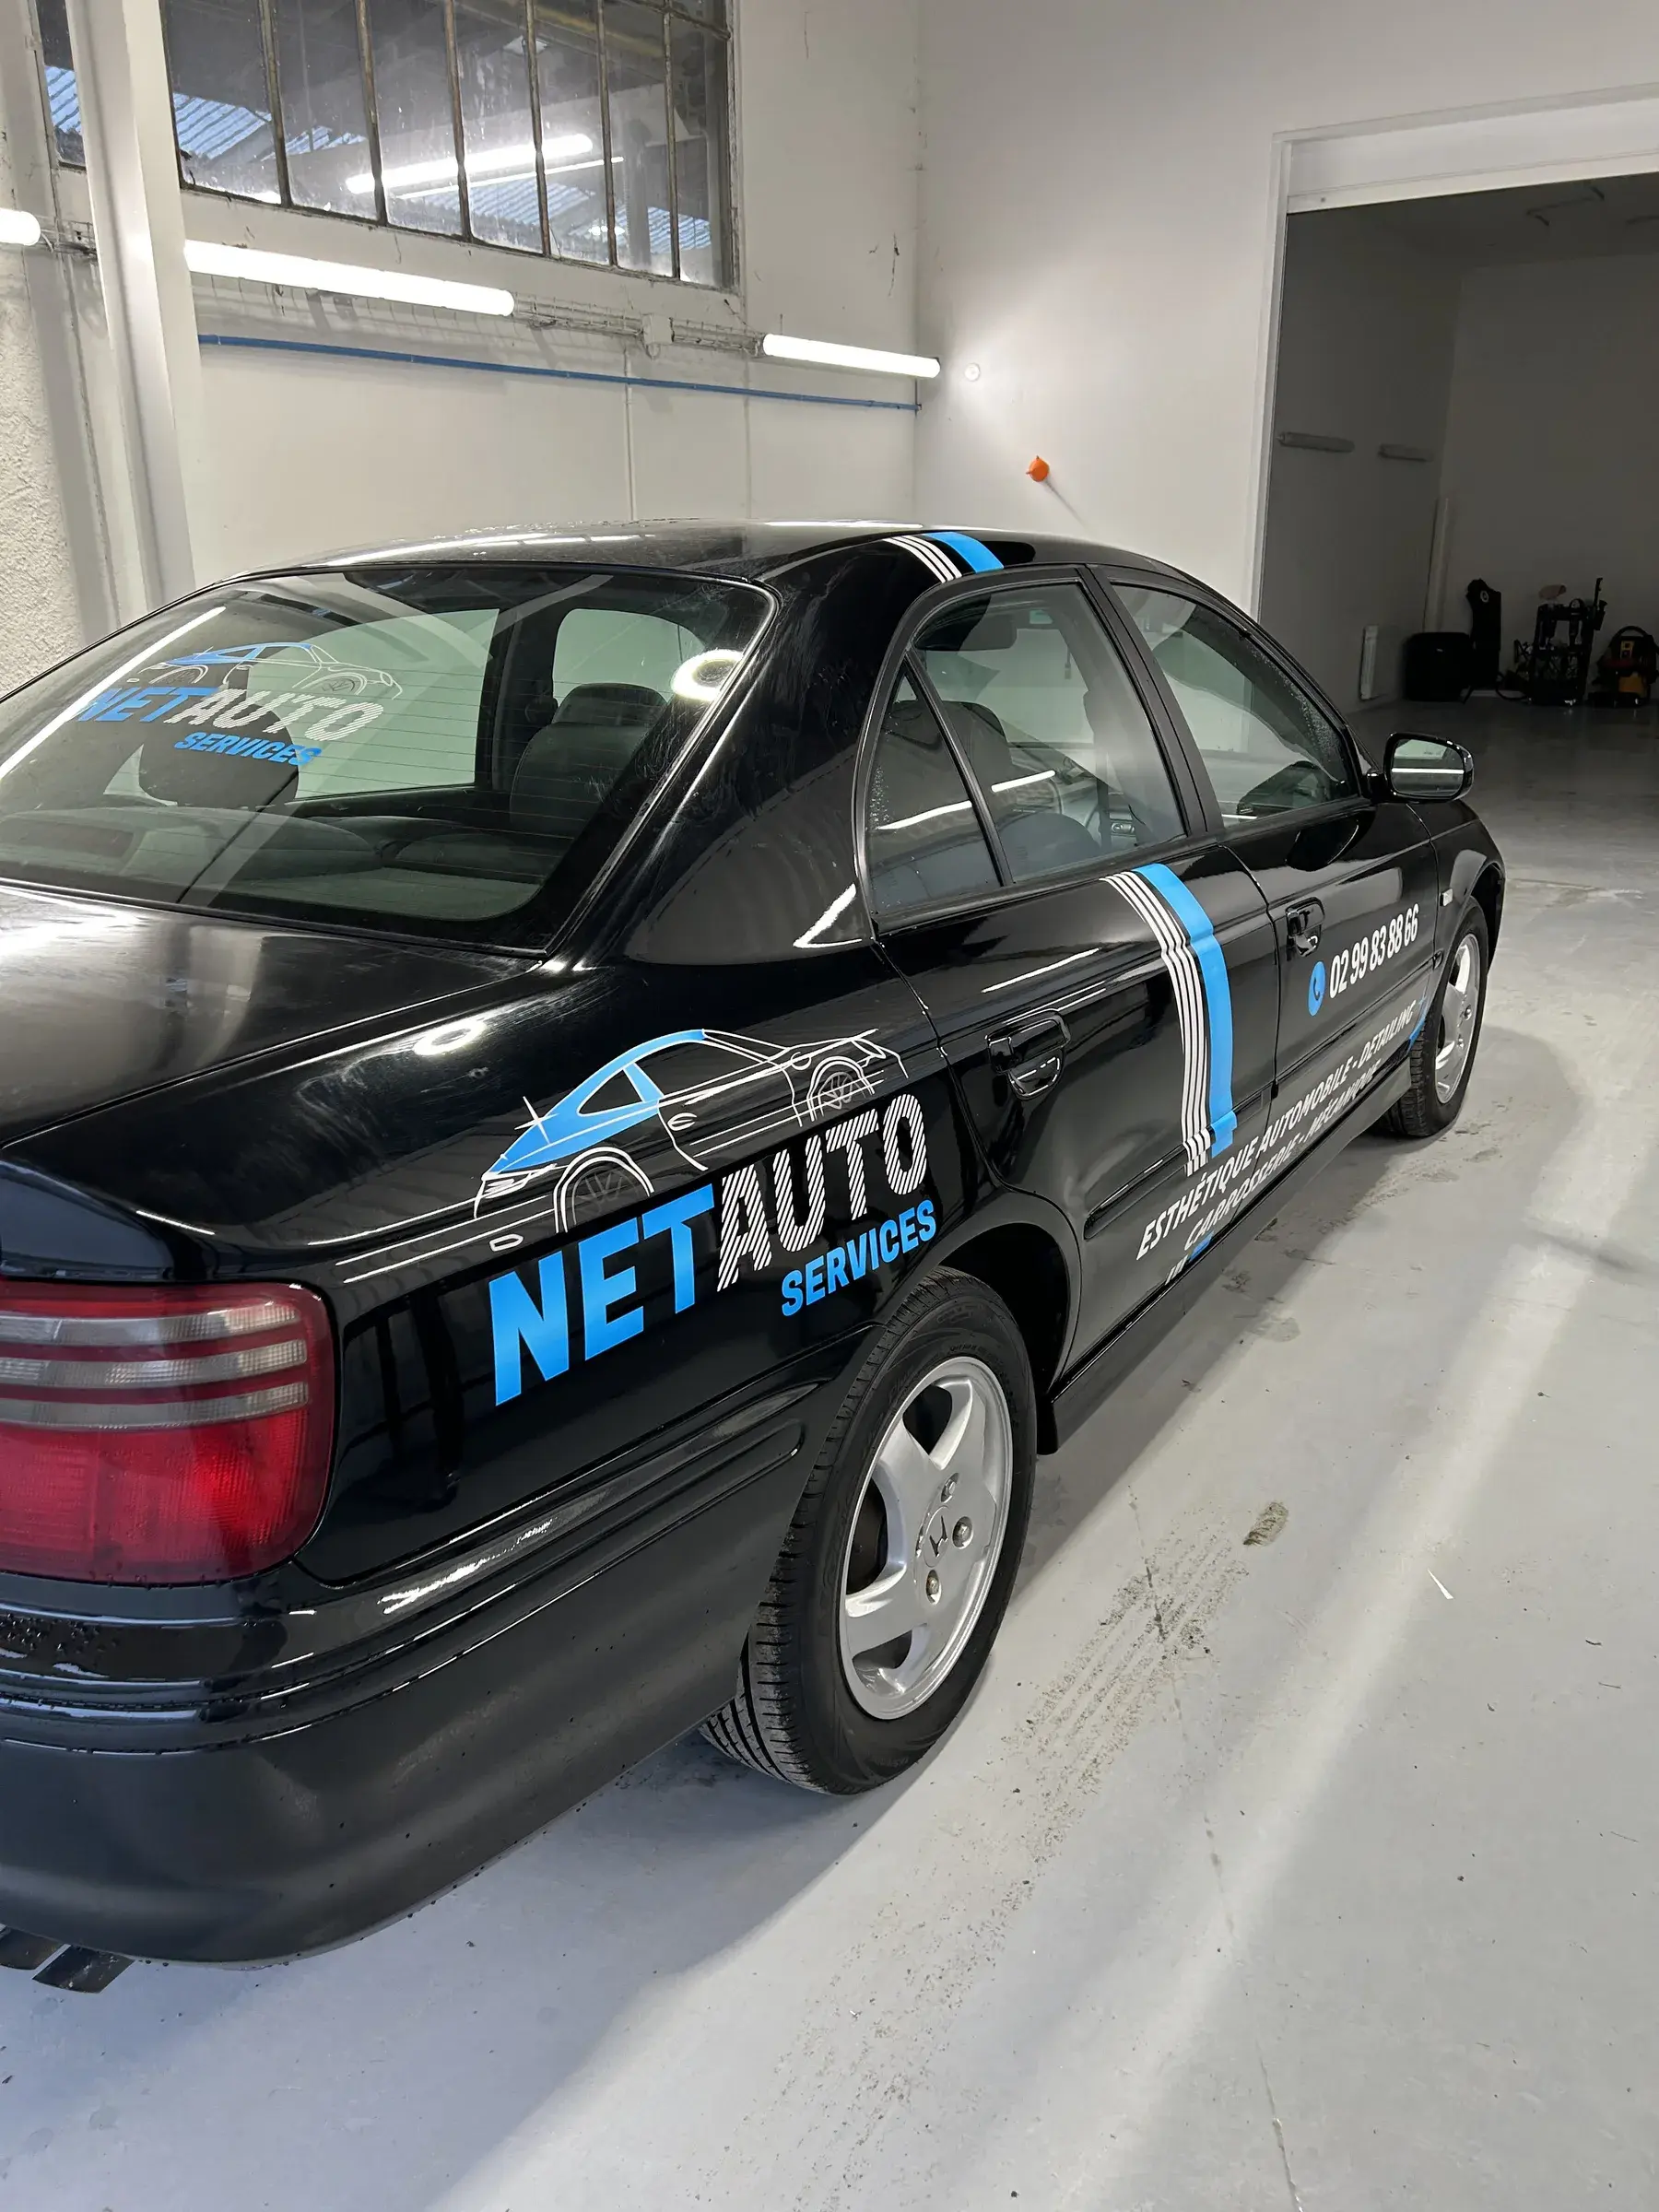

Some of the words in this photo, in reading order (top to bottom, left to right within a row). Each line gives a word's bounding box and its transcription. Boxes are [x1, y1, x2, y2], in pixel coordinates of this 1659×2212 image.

[174, 732, 322, 766] SERVICES
[1330, 949, 1349, 999] 02
[1350, 936, 1369, 984] 99
[1370, 925, 1387, 971] 83
[1387, 913, 1404, 959] 88
[1404, 903, 1419, 947] 66
[1135, 1135, 1259, 1261] ESTHÉTIQUE
[1255, 1055, 1354, 1159] AUTOMOBILE
[1358, 999, 1417, 1069] DETAILING
[782, 1199, 936, 1316] SERVICES
